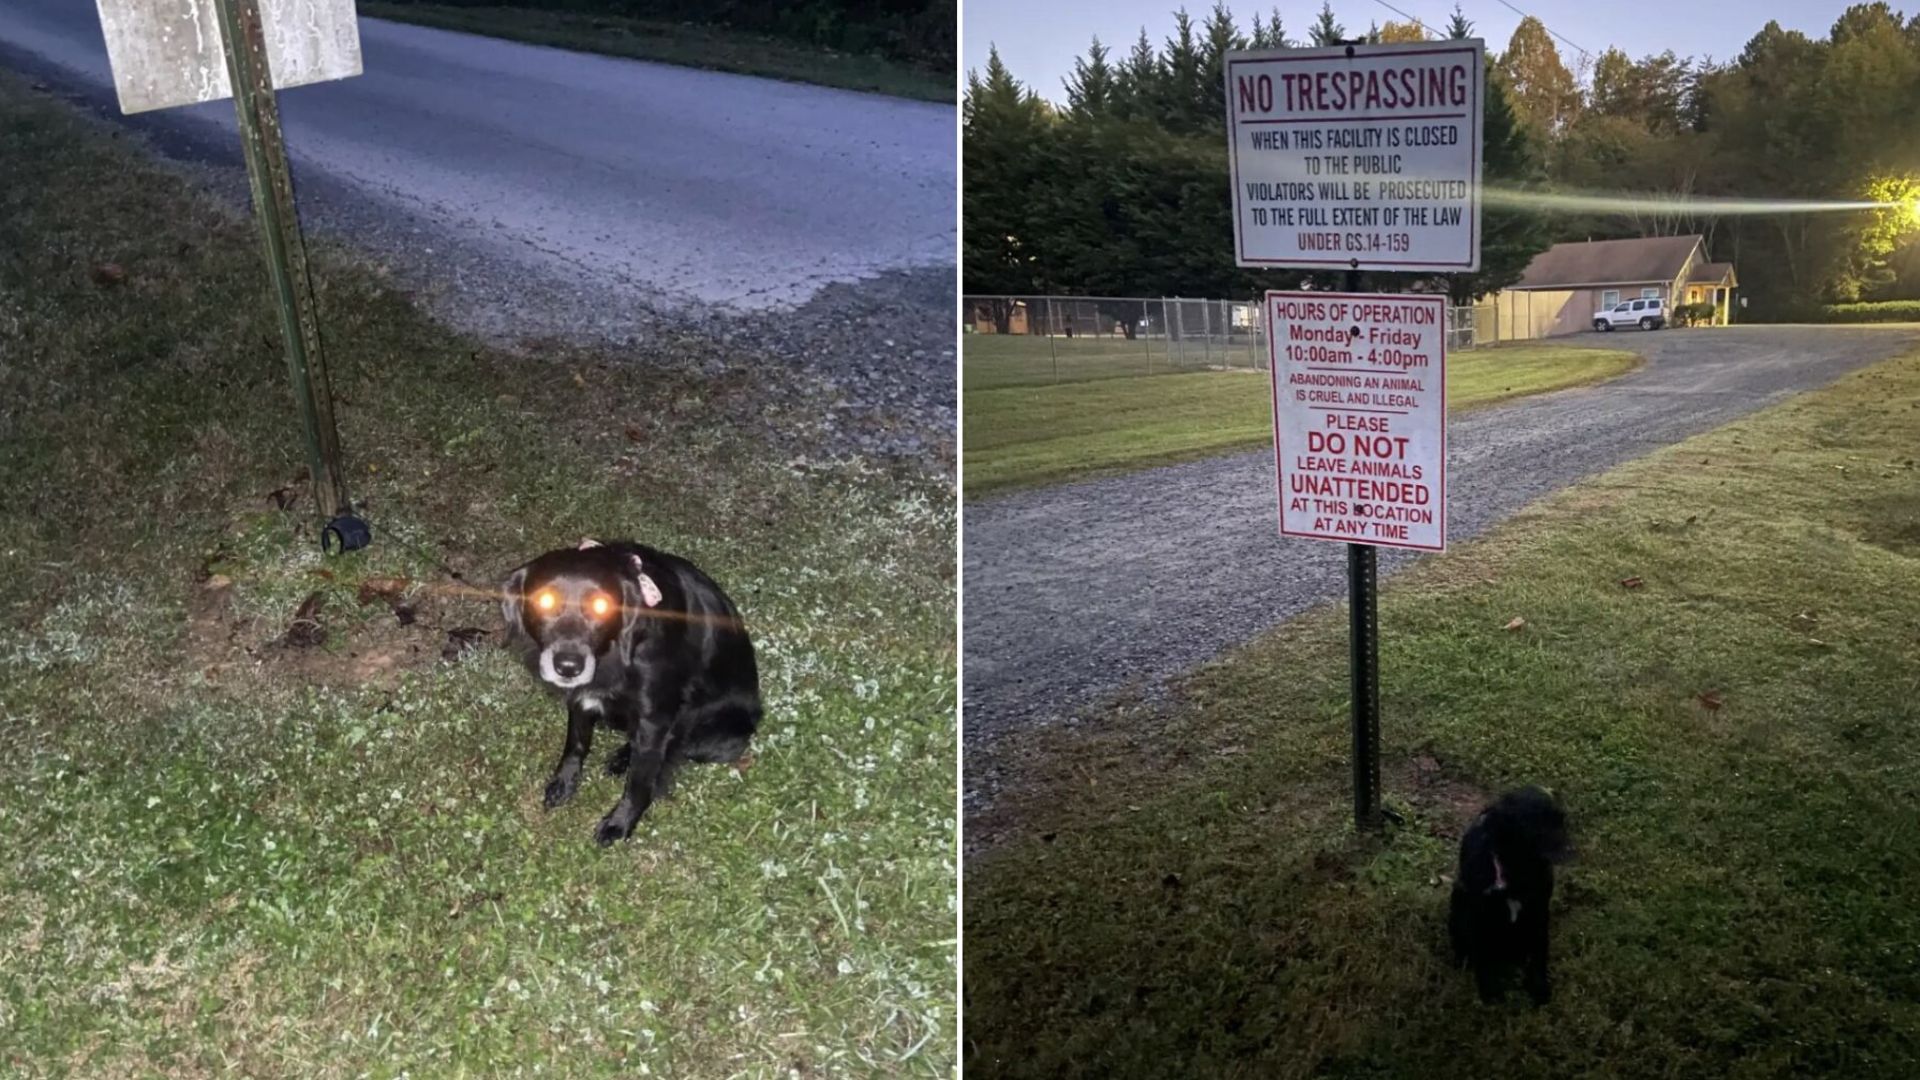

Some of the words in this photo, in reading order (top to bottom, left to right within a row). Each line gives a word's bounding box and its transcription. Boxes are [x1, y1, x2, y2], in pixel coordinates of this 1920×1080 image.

[1239, 74, 1272, 113] NO
[1282, 65, 1466, 111] TRESPASSING
[1251, 131, 1288, 150] WHEN
[1293, 130, 1322, 149] THIS
[1327, 128, 1383, 148] FACILITY
[1387, 127, 1399, 146] IS
[1405, 126, 1457, 146] CLOSED
[1304, 156, 1320, 175] TO
[1325, 156, 1348, 174] THE
[1354, 155, 1402, 174] PUBLIC
[1247, 182, 1314, 201] VIOLATORS
[1318, 182, 1349, 200] WILL
[1354, 182, 1370, 200] BE
[1380, 180, 1466, 199] PROSECUTED
[1252, 208, 1267, 226] TO
[1272, 208, 1294, 226] THE
[1299, 208, 1328, 226] FULL
[1333, 208, 1379, 226] EXTENT
[1384, 208, 1399, 226] OF
[1404, 207, 1427, 226] THE
[1433, 207, 1461, 226] LAW
[1298, 233, 1341, 250] UNDER
[1277, 302, 1325, 321] HOURS
[1330, 304, 1348, 322] OF
[1353, 305, 1435, 324] OPERATION
[1290, 325, 1353, 347] Monday
[1370, 328, 1421, 349] Friday
[1286, 346, 1352, 363] 10:00am
[1368, 349, 1428, 370] 4:00pm
[1290, 374, 1361, 388] ABANDONING
[1365, 377, 1380, 389] AN
[1382, 378, 1424, 391] ANIMAL
[1296, 390, 1306, 400] IS
[1309, 391, 1344, 403] CRUEL
[1347, 393, 1370, 404] AND
[1373, 395, 1418, 407] ILLEGAL
[1327, 414, 1389, 432] PLEASE
[1309, 432, 1345, 454] DO
[1354, 434, 1409, 459] NOT
[1298, 456, 1346, 473] LEAVE
[1351, 462, 1422, 480] ANIMALS
[1291, 474, 1429, 505] UNATTENDED
[1291, 499, 1309, 512] AT
[1314, 500, 1347, 514] THIS
[1314, 518, 1332, 531] AT
[1336, 520, 1367, 534] ANY
[1373, 523, 1408, 539] TIME
